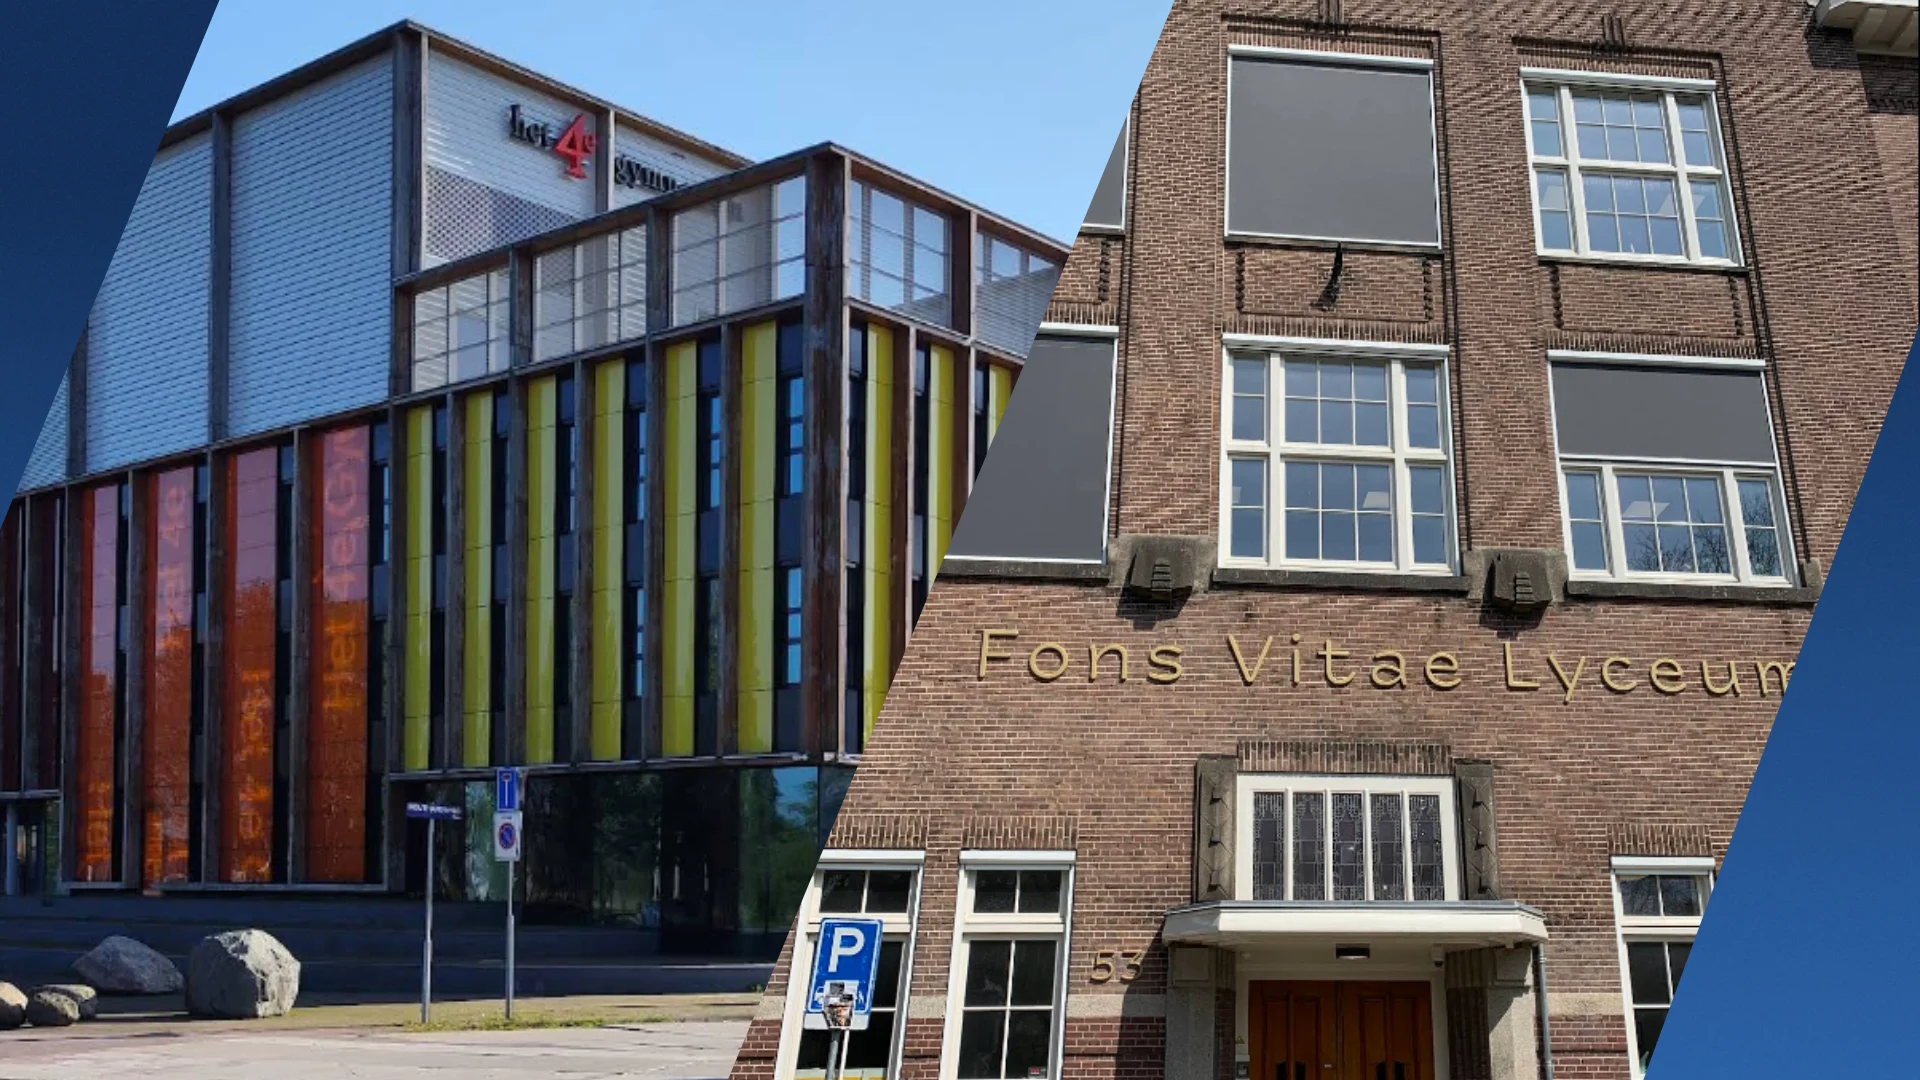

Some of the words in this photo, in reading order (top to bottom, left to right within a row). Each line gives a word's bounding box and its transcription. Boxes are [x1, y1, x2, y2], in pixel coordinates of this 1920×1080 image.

[509, 104, 549, 148] het
[978, 629, 1183, 682] Fons
[1228, 632, 1462, 688] Vitae
[828, 927, 865, 972] P
[1090, 950, 1143, 981] 53
